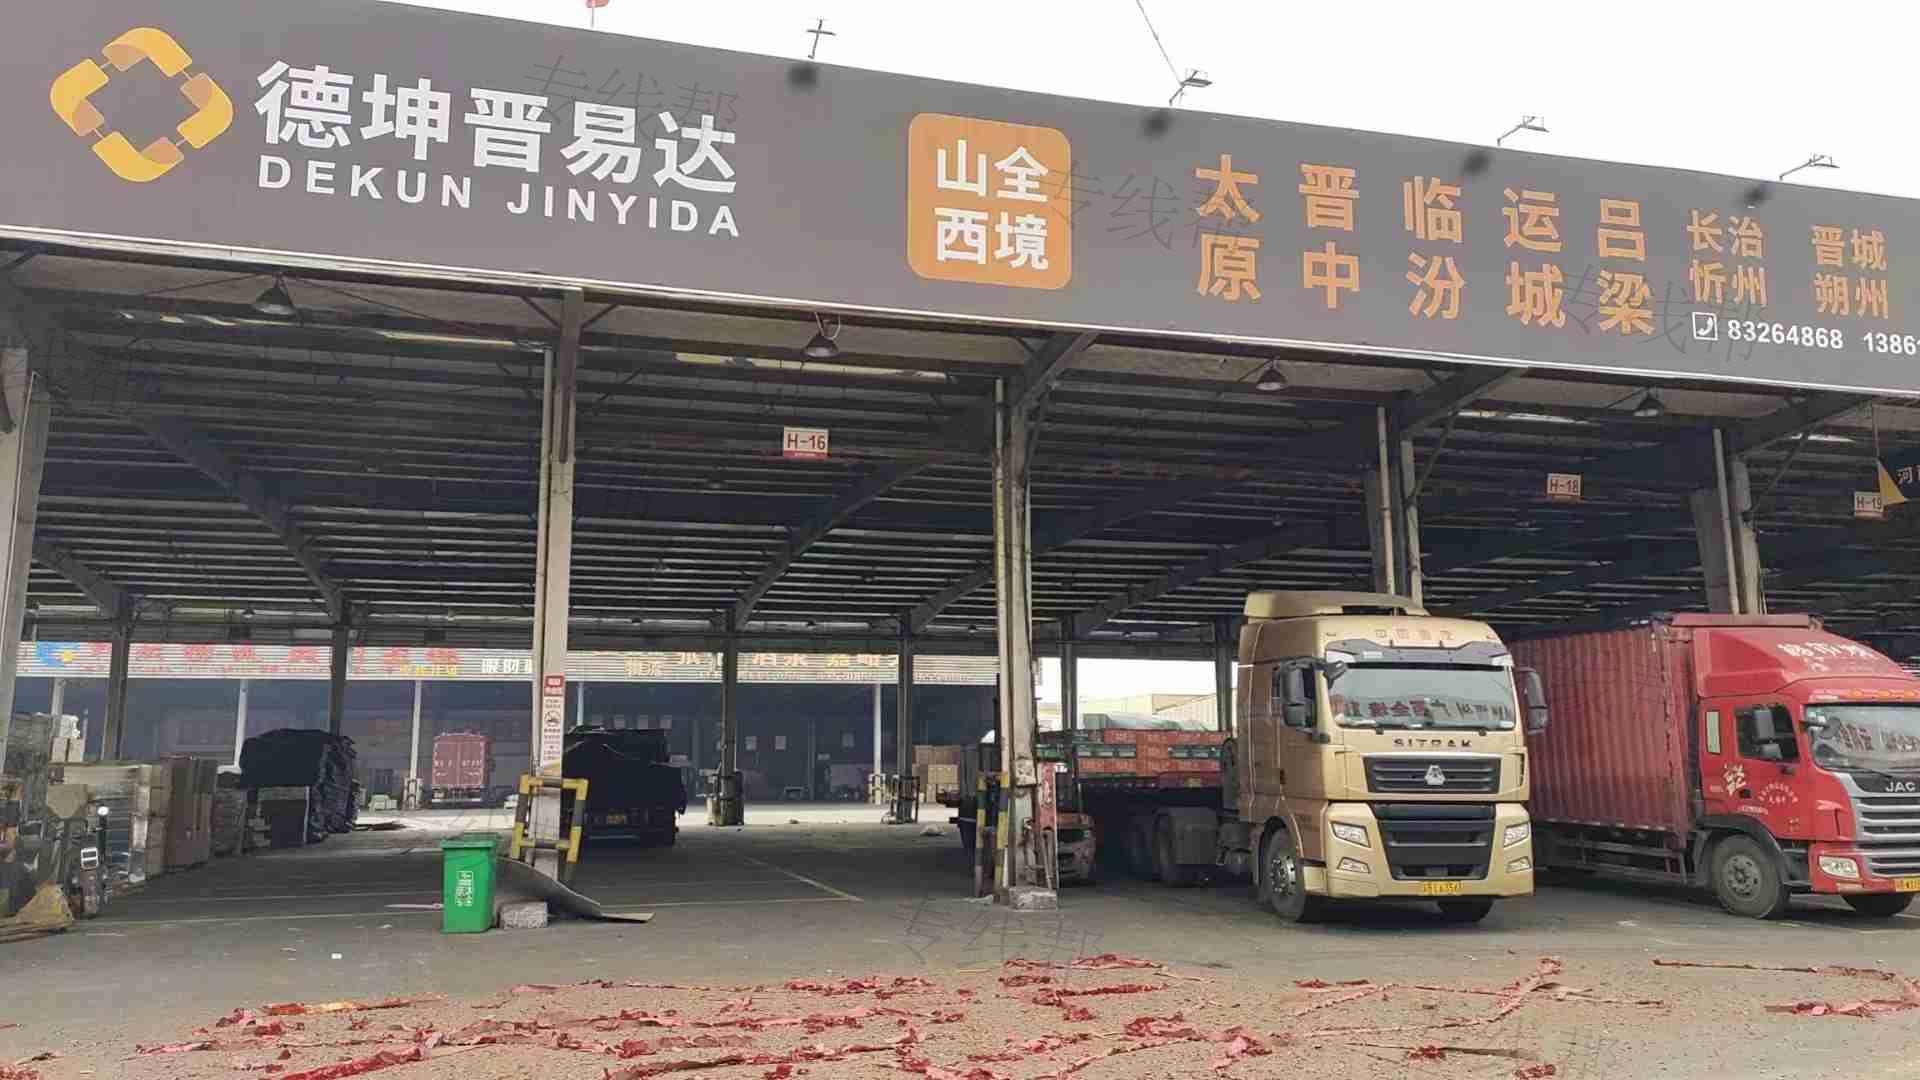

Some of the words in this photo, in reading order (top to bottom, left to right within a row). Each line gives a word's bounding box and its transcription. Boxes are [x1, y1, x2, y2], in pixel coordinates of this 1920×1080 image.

[254, 60, 738, 194] 德坤晋易达
[258, 154, 471, 209] DEKUN
[506, 189, 741, 238] JINYIDA
[1686, 210, 1763, 259] 长治
[1811, 225, 1888, 271] 晋城
[1689, 259, 1768, 307] 忻州
[1811, 272, 1890, 319] 朔州
[1727, 319, 1844, 350] 83264868
[787, 433, 826, 451] H-16
[1895, 465, 1920, 485] 河
[1551, 479, 1577, 493] H-18
[1856, 496, 1882, 510] H-19
[1393, 738, 1472, 749] SITRAK
[1885, 780, 1917, 793] JAC
